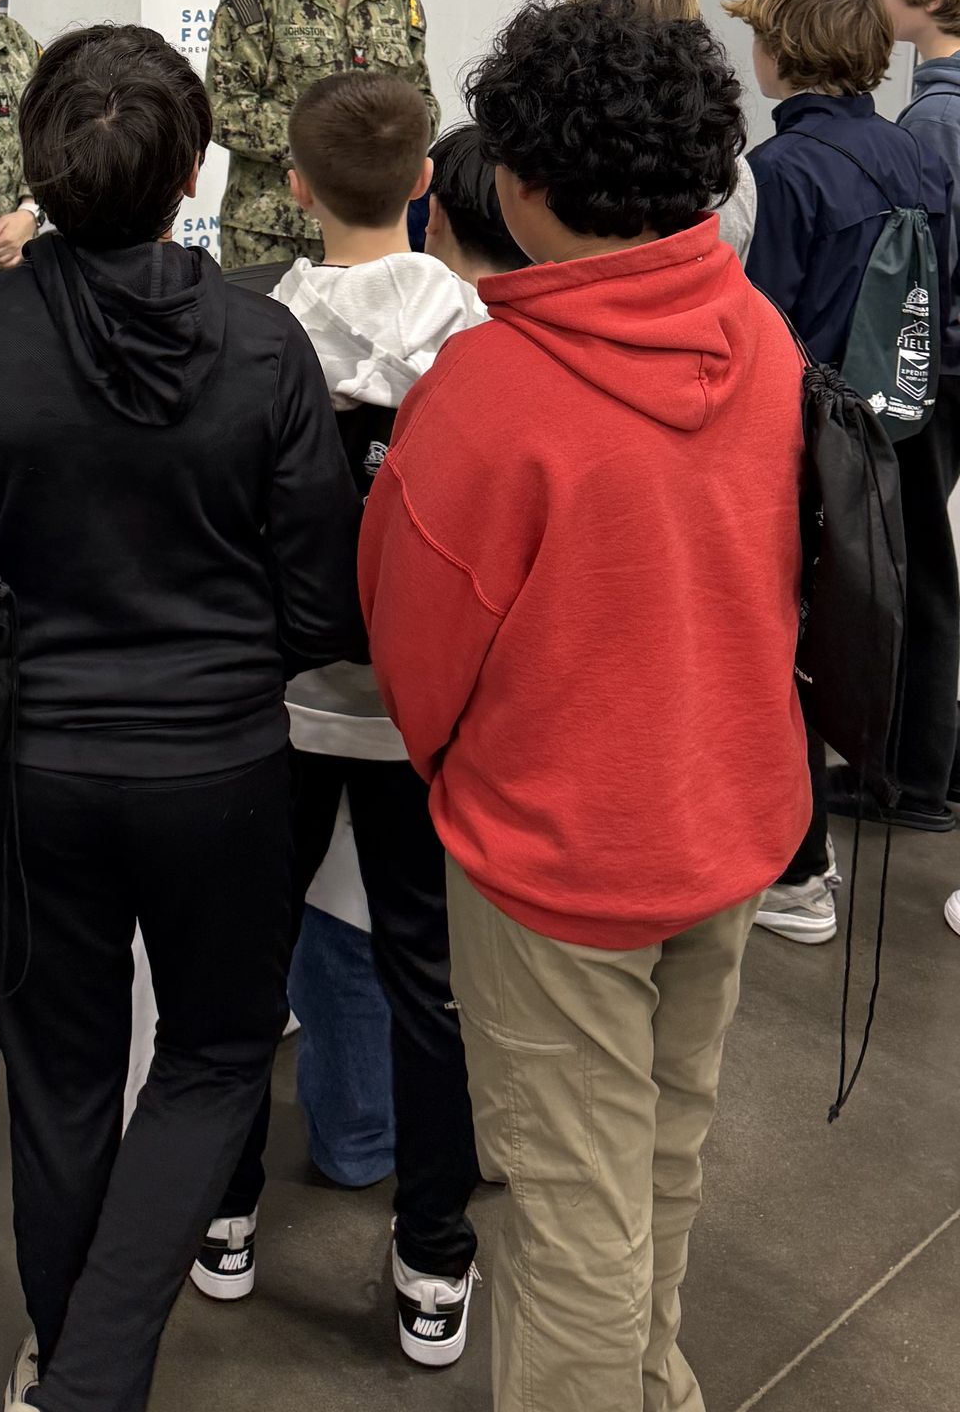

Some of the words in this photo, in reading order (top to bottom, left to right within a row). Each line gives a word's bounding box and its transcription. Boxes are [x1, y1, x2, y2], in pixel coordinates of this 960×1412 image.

[283, 26, 326, 37] JOHNSTON
[218, 1249, 249, 1271] NIKE
[412, 1316, 447, 1337] NIKE
